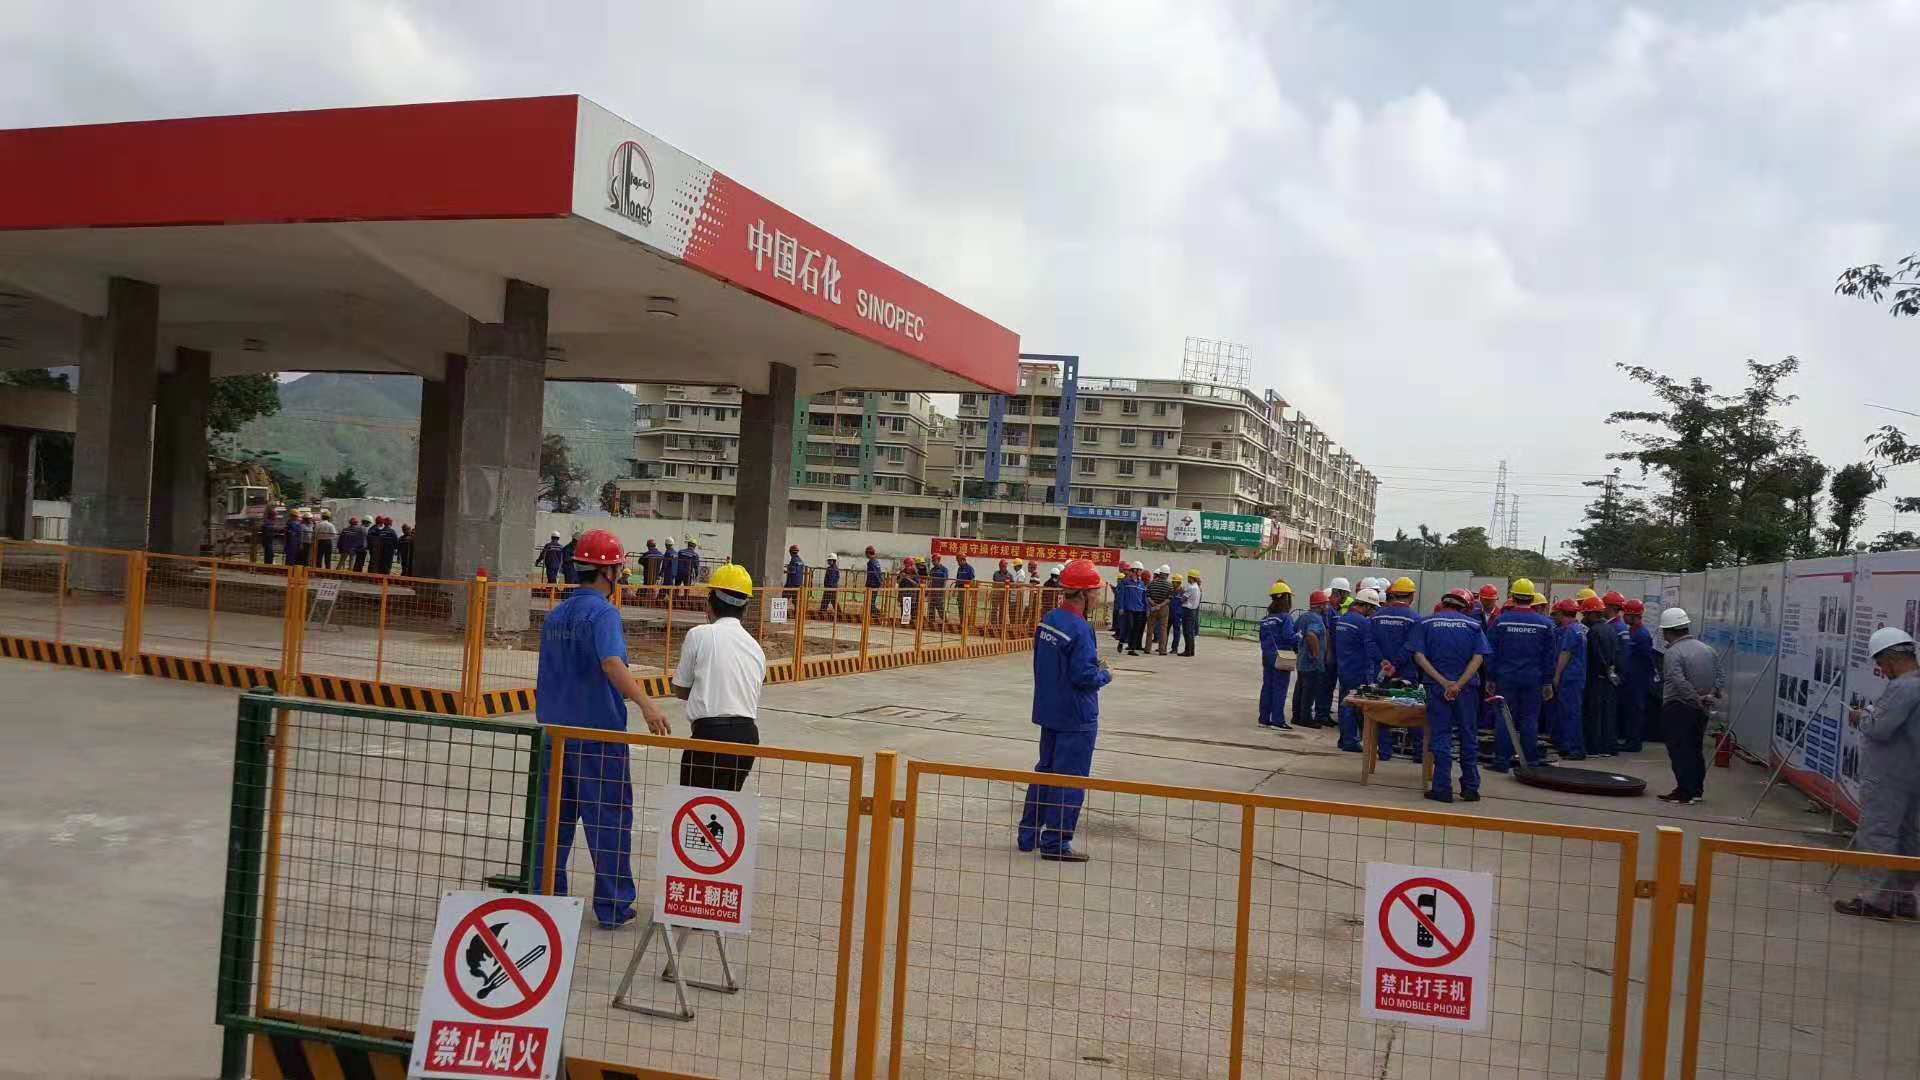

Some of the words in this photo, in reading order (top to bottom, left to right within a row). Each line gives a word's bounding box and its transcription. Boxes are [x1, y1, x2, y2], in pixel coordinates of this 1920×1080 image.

[747, 218, 842, 305] 中国石化
[856, 288, 925, 342] SINOPEC
[938, 541, 1020, 557] 严格遵守操作规程
[1433, 620, 1467, 628] SINOPEC
[1507, 626, 1537, 634] SINOPEC
[669, 881, 739, 910] 禁止翻越
[680, 904, 715, 916] CLIMBING
[717, 909, 738, 919] OVER
[1381, 973, 1466, 1002] 禁止打手机
[1381, 996, 1395, 1007] NO
[1396, 998, 1432, 1012] MOBILE
[1433, 1003, 1466, 1016] PHONE
[432, 1026, 539, 1073] 禁止烟火
